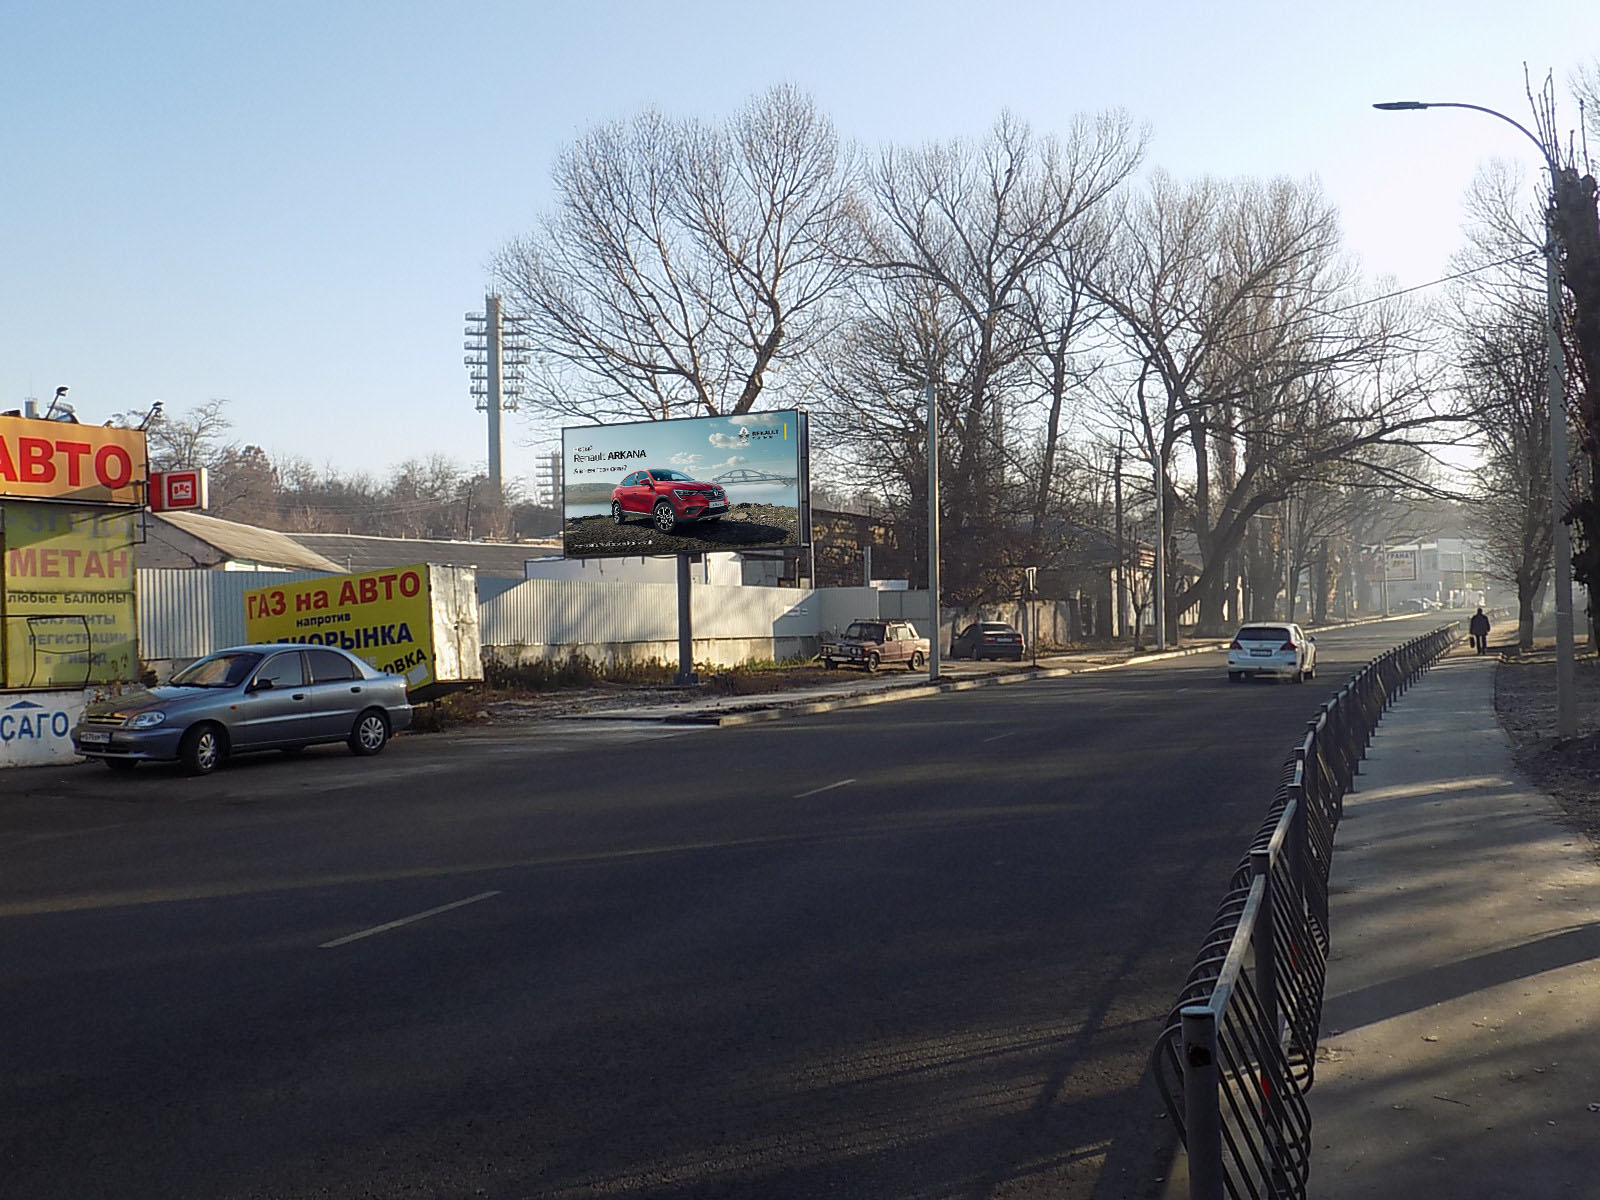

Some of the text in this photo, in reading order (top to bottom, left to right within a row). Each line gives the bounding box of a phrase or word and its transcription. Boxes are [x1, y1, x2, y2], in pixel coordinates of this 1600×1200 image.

[607, 449, 647, 461] ARKANA
[174, 484, 190, 494] BRC
[9, 548, 128, 578] МЕТАН
[64, 593, 126, 604] БАЛЛОНЫ
[247, 571, 420, 620] ГАЗ на АВТО
[296, 612, 351, 628] напротив
[29, 633, 128, 645] РЕГИСТРАЦИИ
[377, 648, 428, 674] ОВКА
